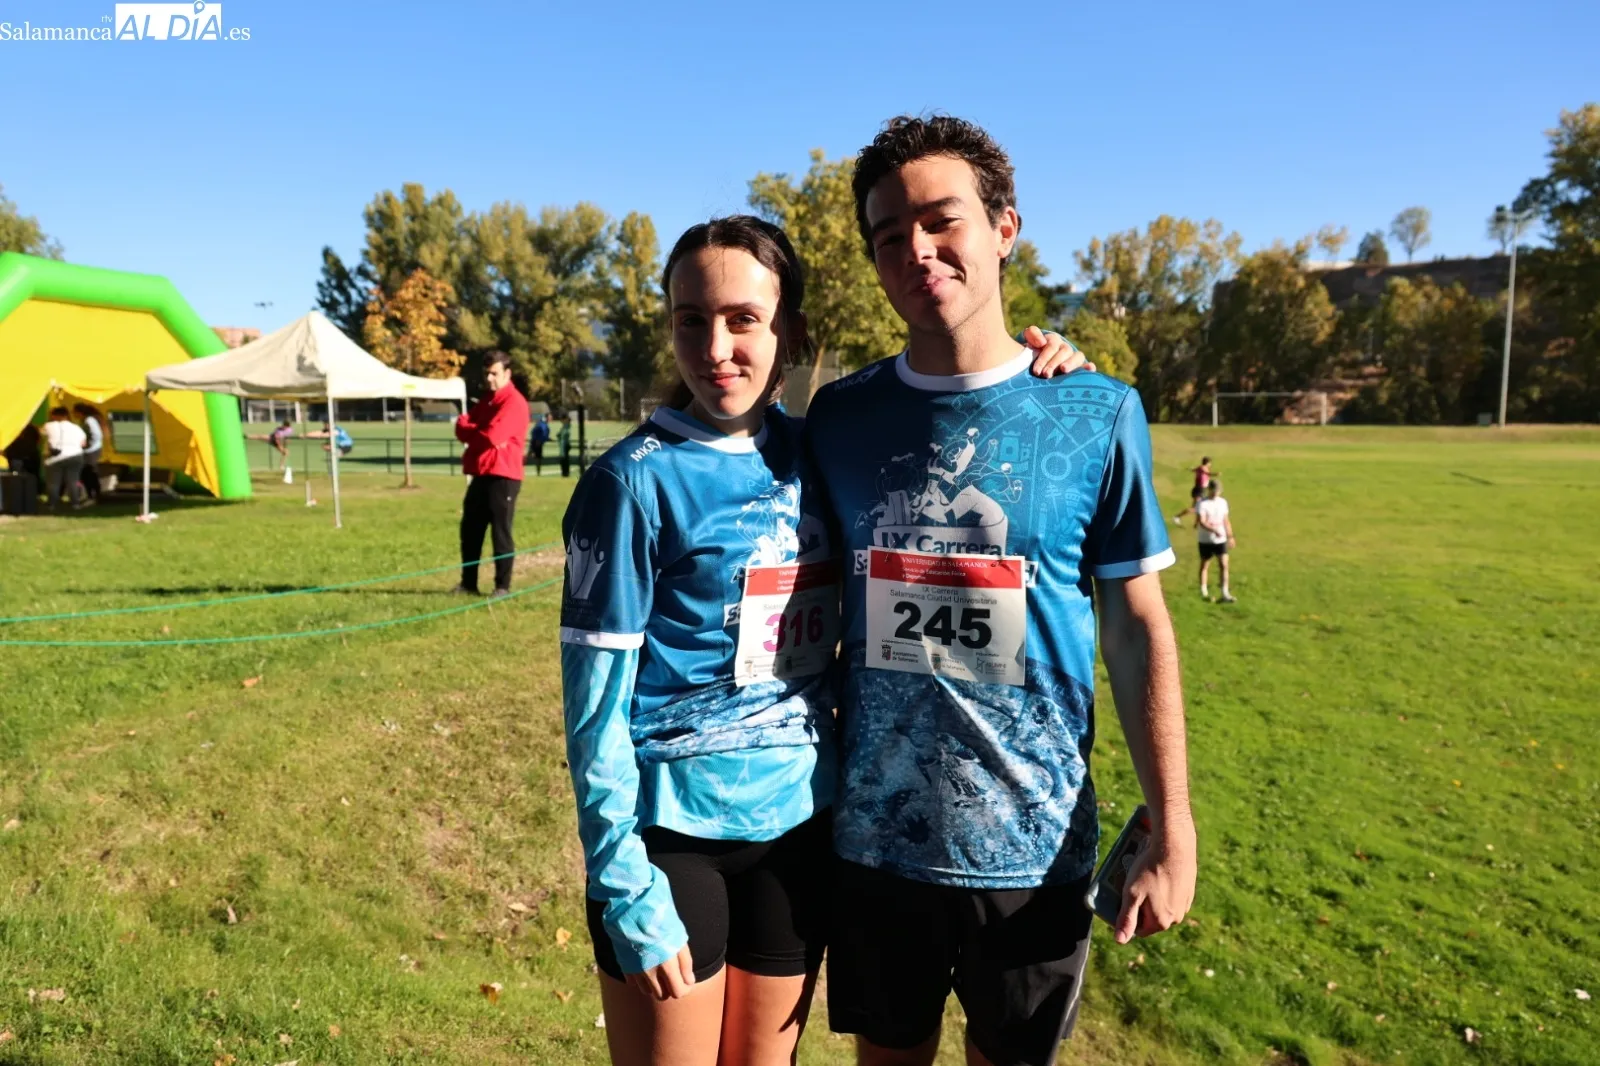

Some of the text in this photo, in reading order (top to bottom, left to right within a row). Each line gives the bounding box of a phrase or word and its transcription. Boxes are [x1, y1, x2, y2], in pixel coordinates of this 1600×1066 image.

[630, 441, 659, 462] MKA
[881, 532, 1002, 556] IX Carrera
[890, 589, 926, 600] Salamanca
[927, 593, 952, 603] Ciudad
[932, 587, 959, 595] Carrera
[763, 605, 824, 653] 316
[893, 601, 993, 650] 245
